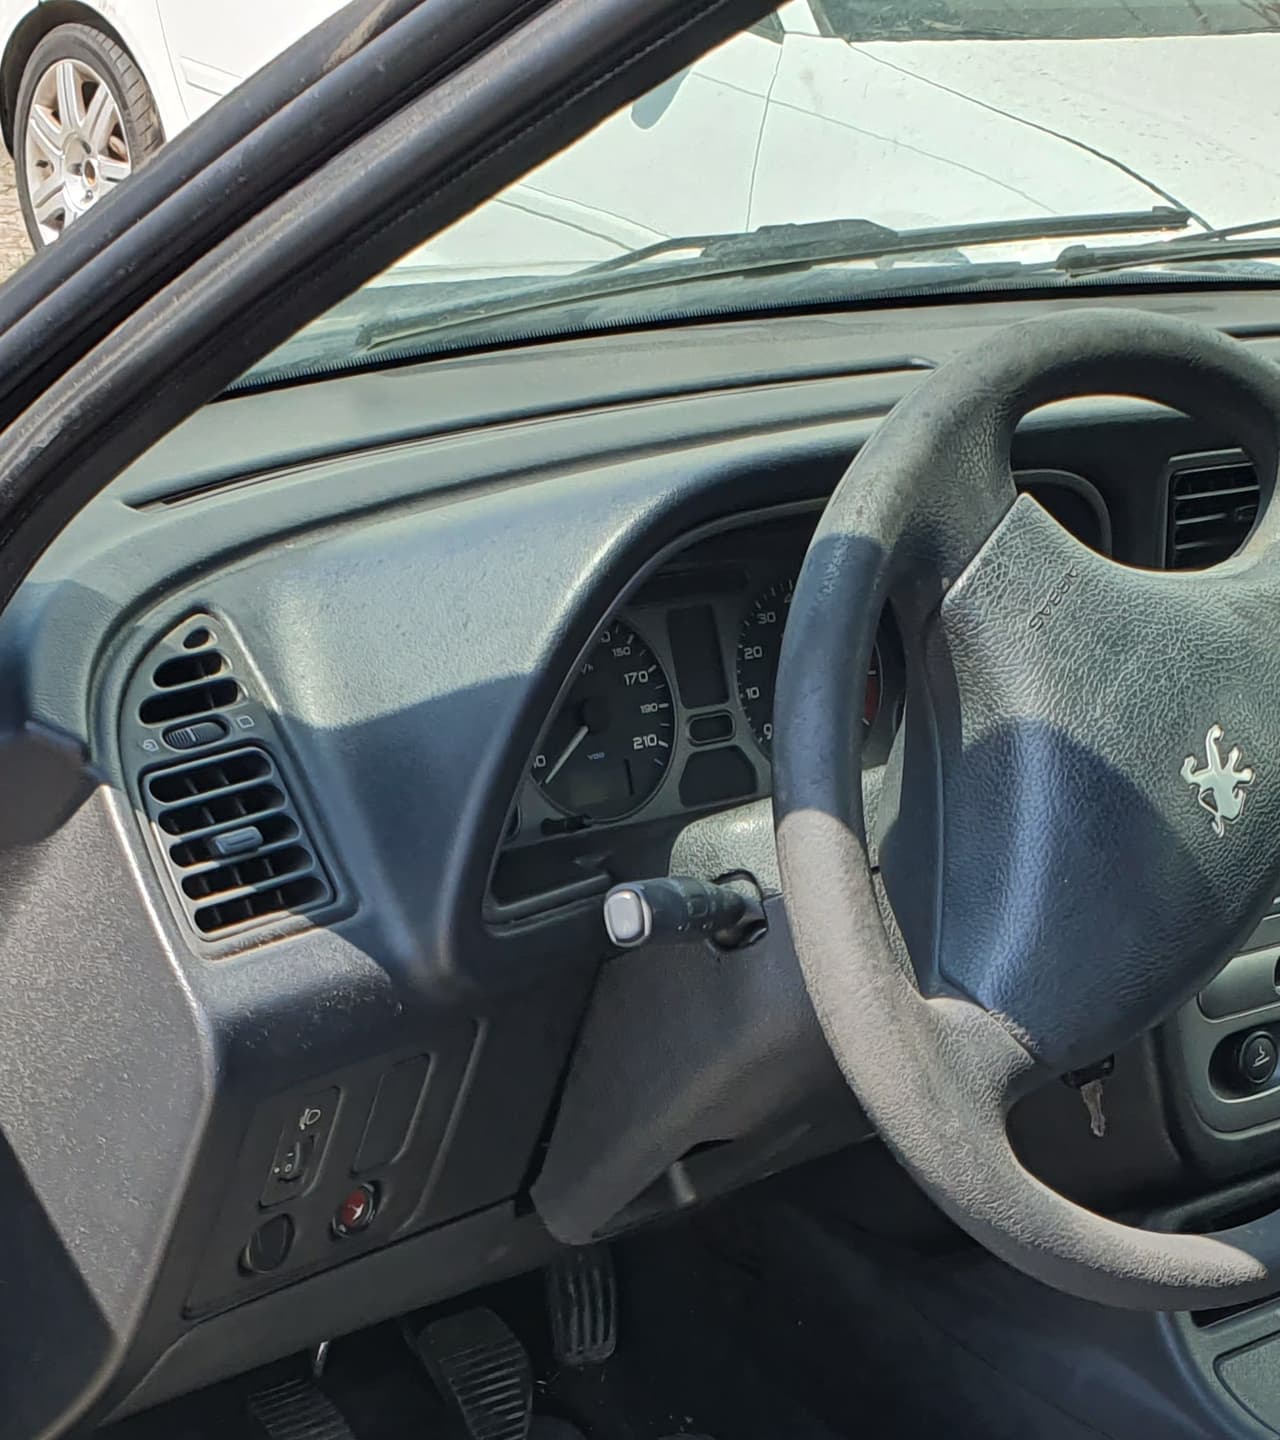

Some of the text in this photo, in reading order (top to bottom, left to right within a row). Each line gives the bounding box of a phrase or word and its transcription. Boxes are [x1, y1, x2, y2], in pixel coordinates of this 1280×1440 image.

[757, 611, 776, 624] 30
[611, 646, 632, 657] 150
[744, 646, 763, 660] 20
[624, 670, 649, 686] 170
[745, 687, 760, 699] 10
[640, 703, 658, 713] 190
[633, 734, 657, 750] 210
